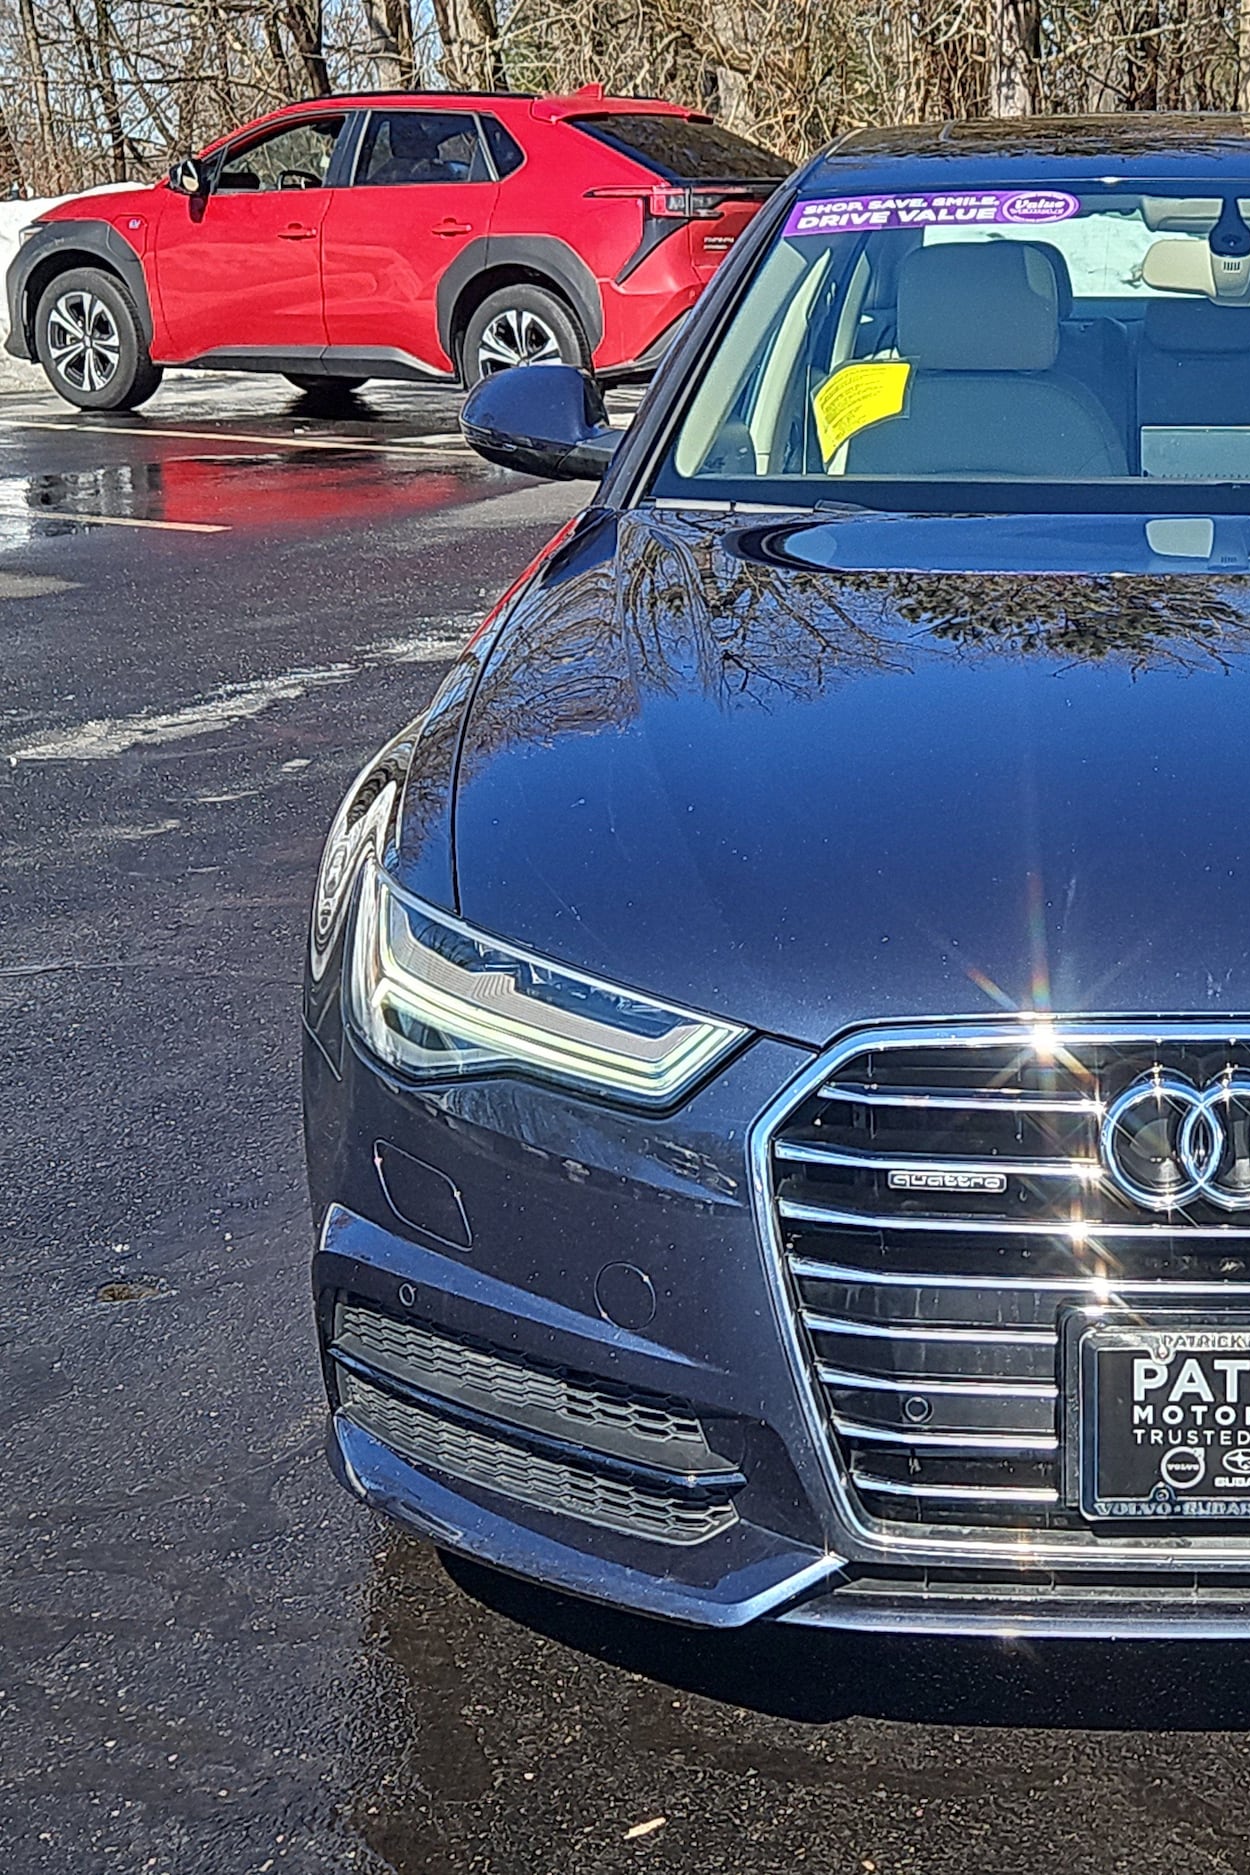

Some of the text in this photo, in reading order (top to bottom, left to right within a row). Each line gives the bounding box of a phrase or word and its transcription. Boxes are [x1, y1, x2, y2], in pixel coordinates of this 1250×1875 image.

[868, 197, 928, 210] SAVE.
[932, 196, 1000, 207] SMILE.
[1014, 199, 1066, 210] Value
[797, 210, 890, 229] DRIVE
[898, 208, 997, 222] VALUE
[892, 1174, 1001, 1188] quattro
[1163, 1334, 1248, 1348] PATRICK
[1166, 1463, 1200, 1471] VOLVO
[1093, 1501, 1172, 1516] VOLVO
